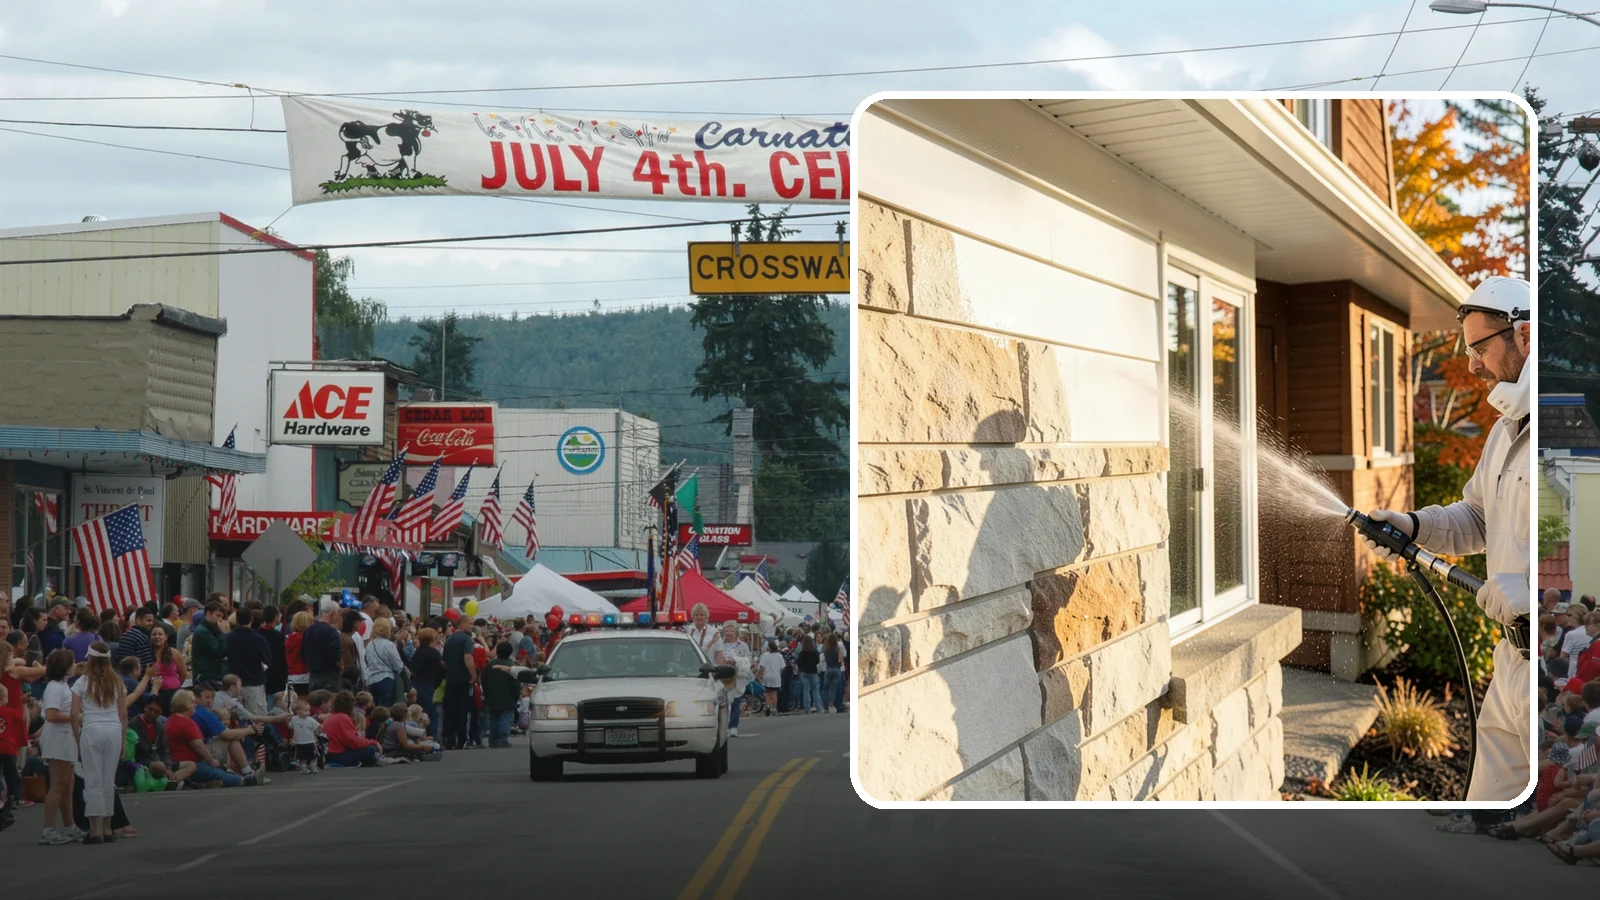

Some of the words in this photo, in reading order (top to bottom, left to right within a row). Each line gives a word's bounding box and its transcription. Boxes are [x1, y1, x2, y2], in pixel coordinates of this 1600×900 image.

[481, 141, 605, 193] JULY
[632, 150, 746, 198] 4th.
[697, 254, 850, 280] CROSSWA
[282, 380, 373, 420] ACE
[283, 421, 370, 436] Hardware
[353, 467, 385, 480] Simpl
[95, 485, 124, 494] Vincent
[126, 486, 135, 494] de
[137, 486, 155, 495] Paul
[212, 516, 331, 535] HARDARE
[687, 526, 742, 535] CRNATION
[698, 535, 730, 544] GLASS
